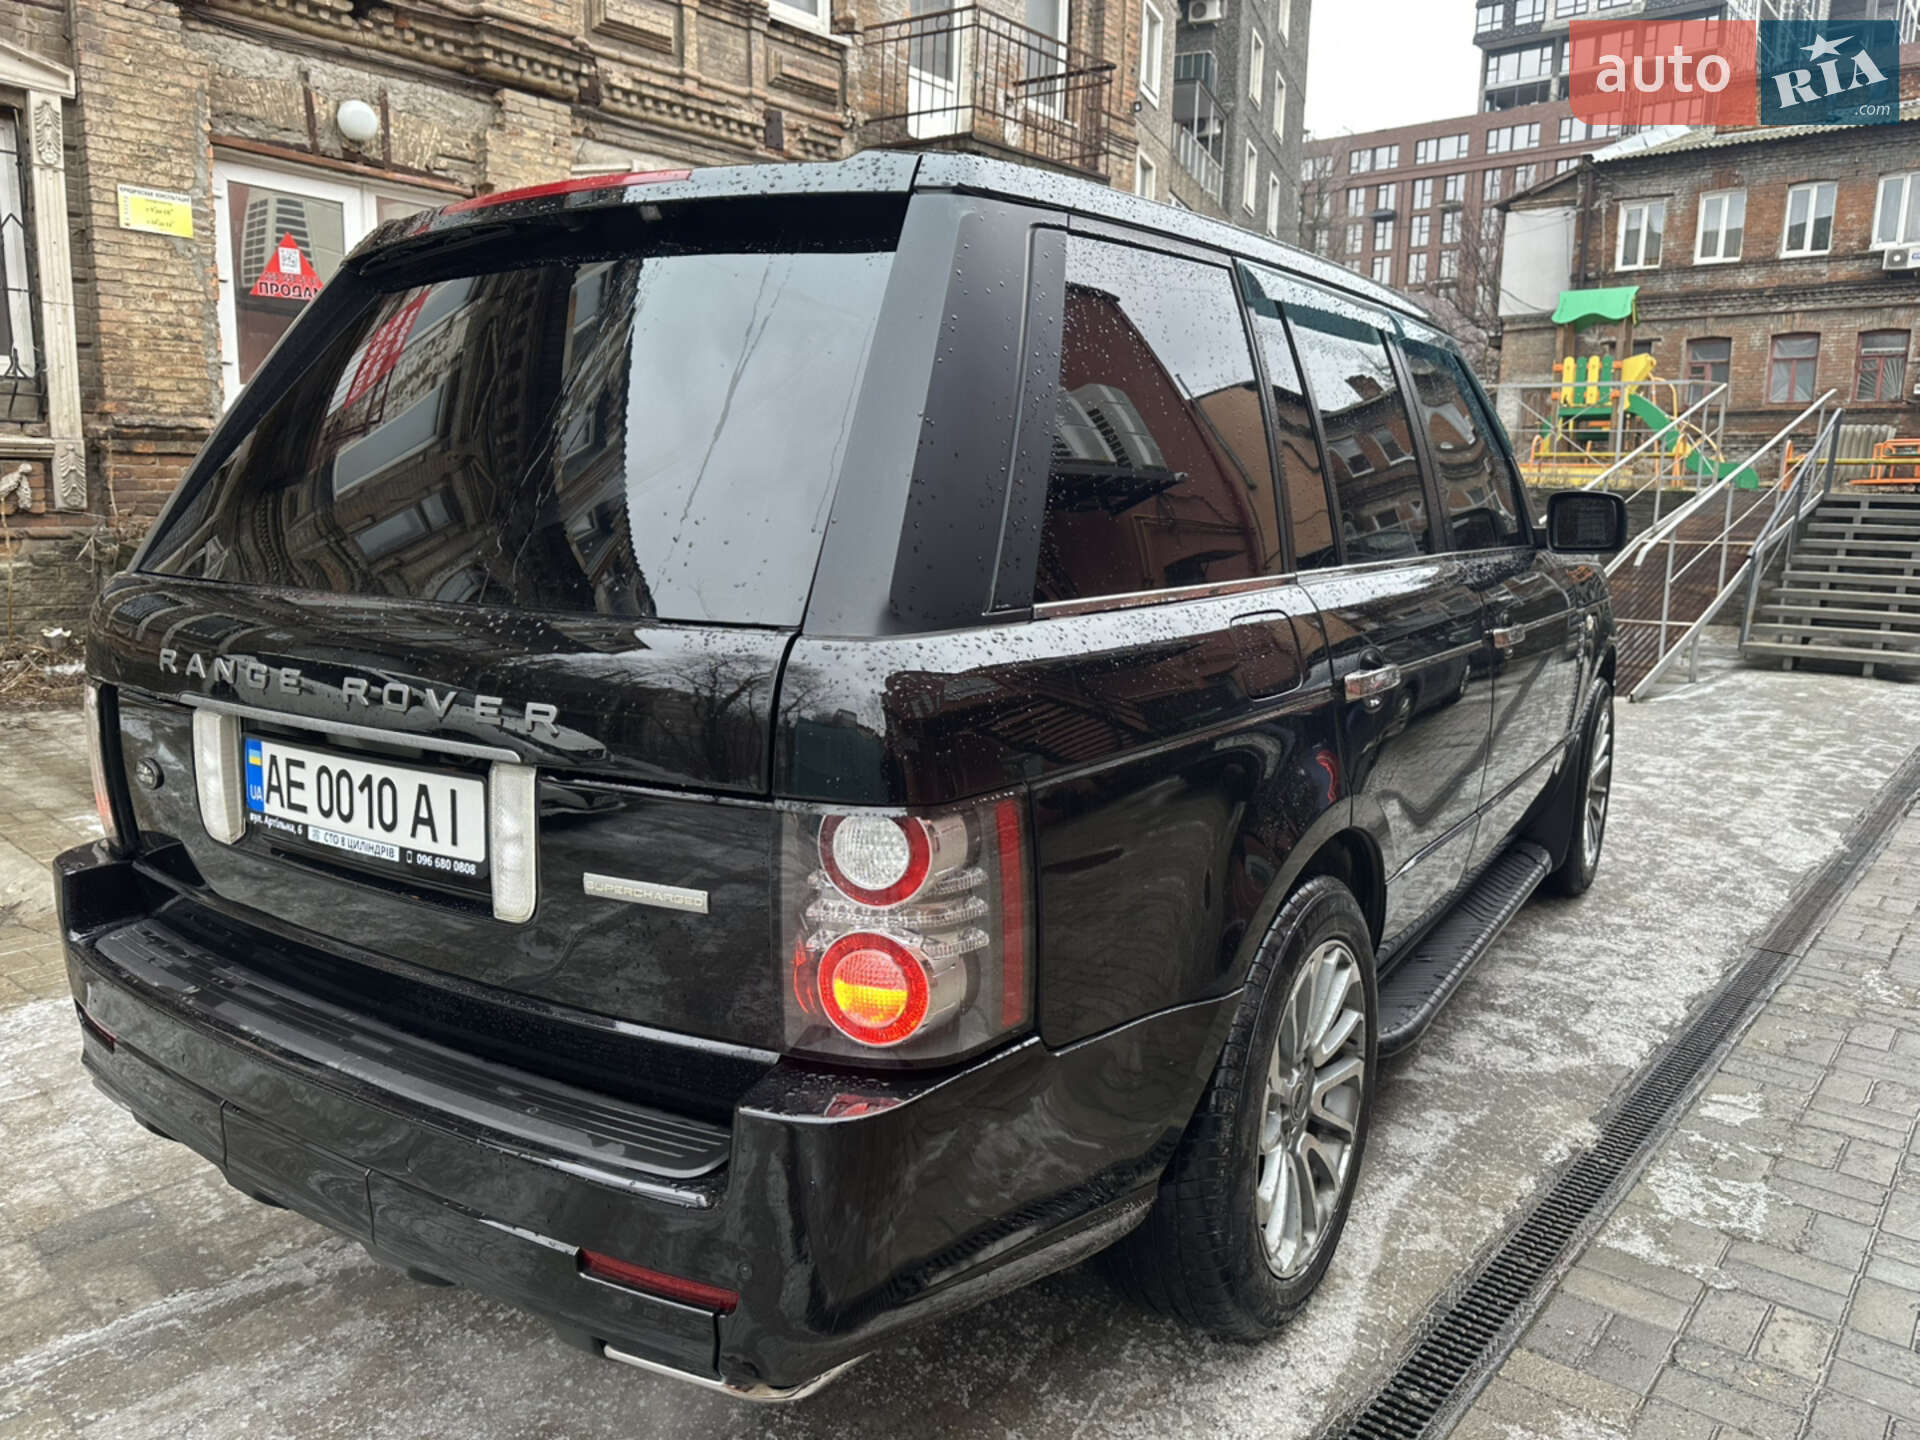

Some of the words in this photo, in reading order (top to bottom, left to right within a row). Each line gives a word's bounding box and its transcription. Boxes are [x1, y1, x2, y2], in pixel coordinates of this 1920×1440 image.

[159, 648, 301, 695] RANGE
[342, 677, 559, 736] ROVER
[249, 784, 264, 801] UA
[265, 753, 308, 814] AE
[316, 764, 398, 833] 0010
[410, 783, 458, 847] AI
[323, 831, 340, 845] СТО
[346, 838, 396, 859] ЦИЛІНДРІВ
[416, 853, 433, 867] 096
[434, 857, 451, 872] 680
[453, 860, 477, 876] 0808
[585, 880, 704, 907] SUPERCHARGED
